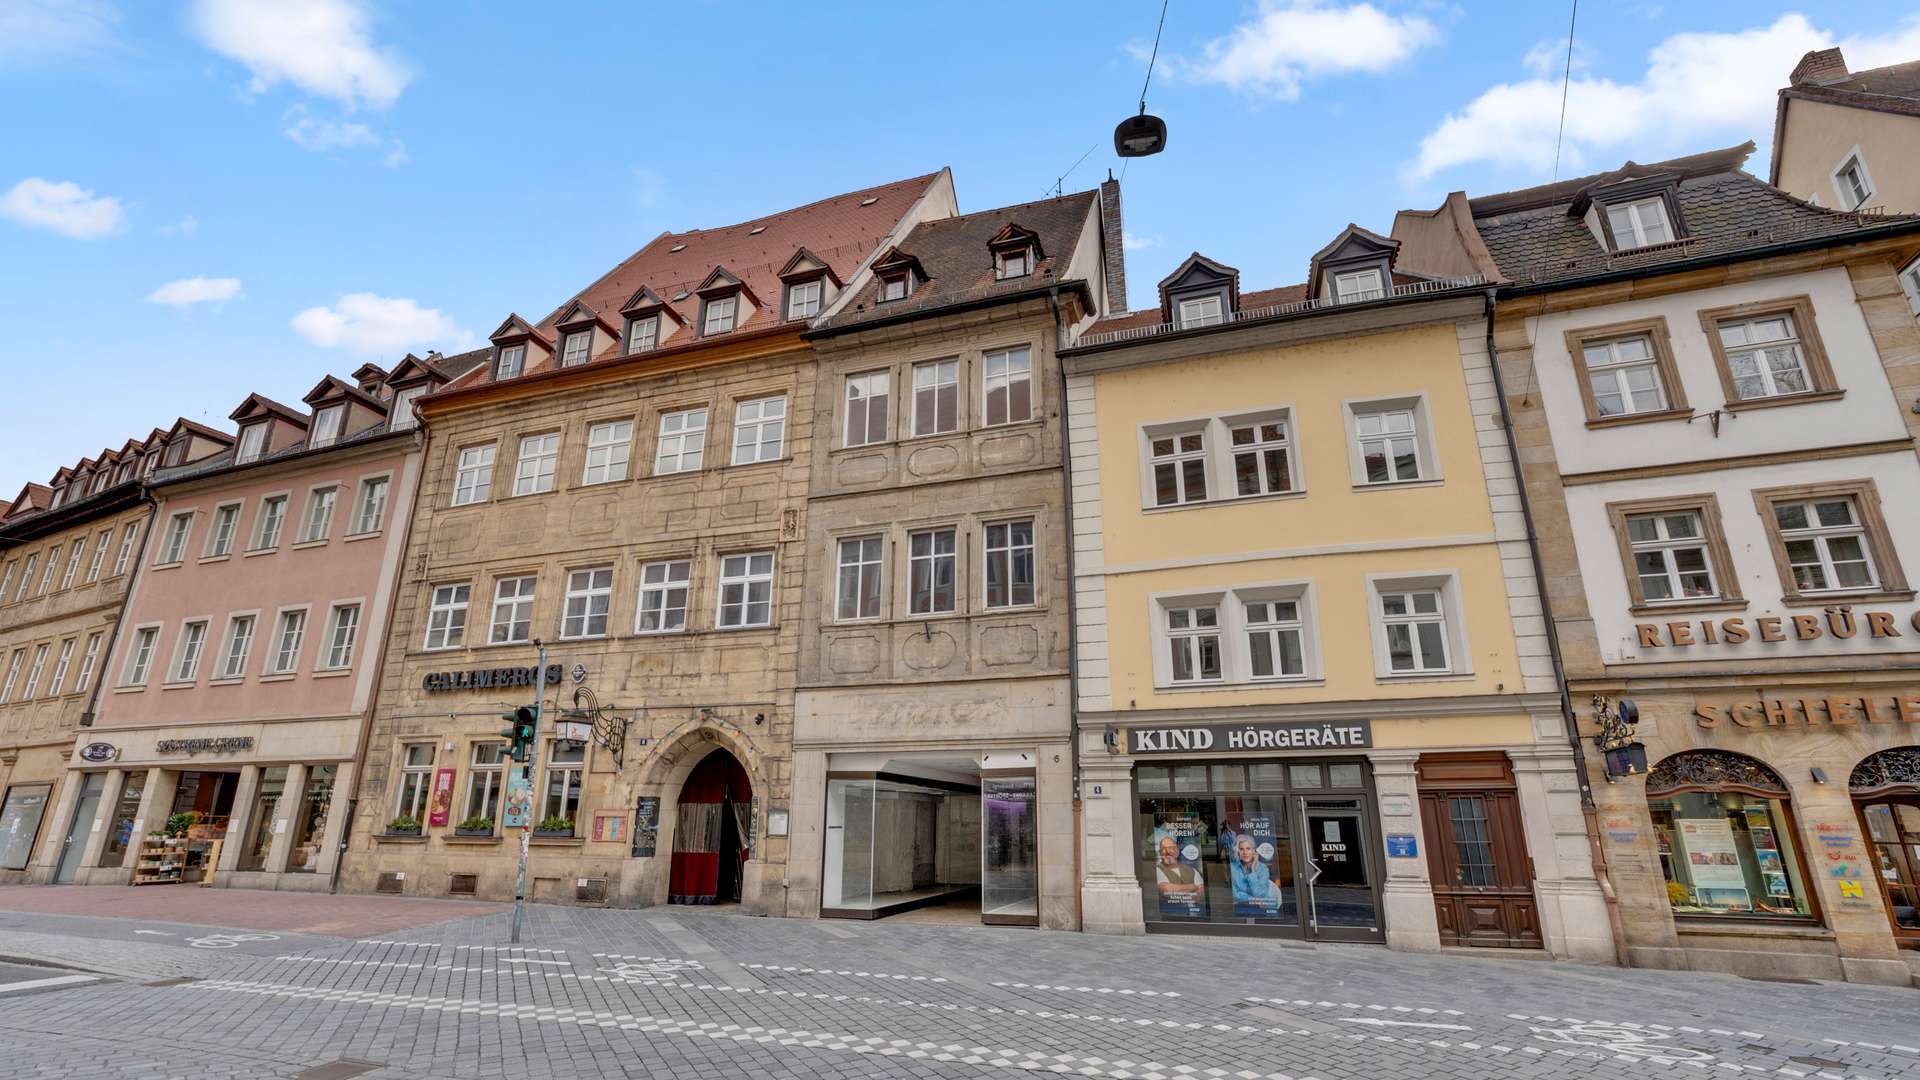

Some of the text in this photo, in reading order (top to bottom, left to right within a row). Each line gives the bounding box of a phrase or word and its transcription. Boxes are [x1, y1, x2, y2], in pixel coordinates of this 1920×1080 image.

[1635, 606, 1920, 648] REISEBÜR
[1135, 724, 1364, 750] KIND HÖRGERÄTE
[1054, 755, 1060, 763] 6
[1166, 822, 1192, 830] BESSER
[1240, 821, 1255, 829] HÖR
[1321, 843, 1346, 851] KIND
